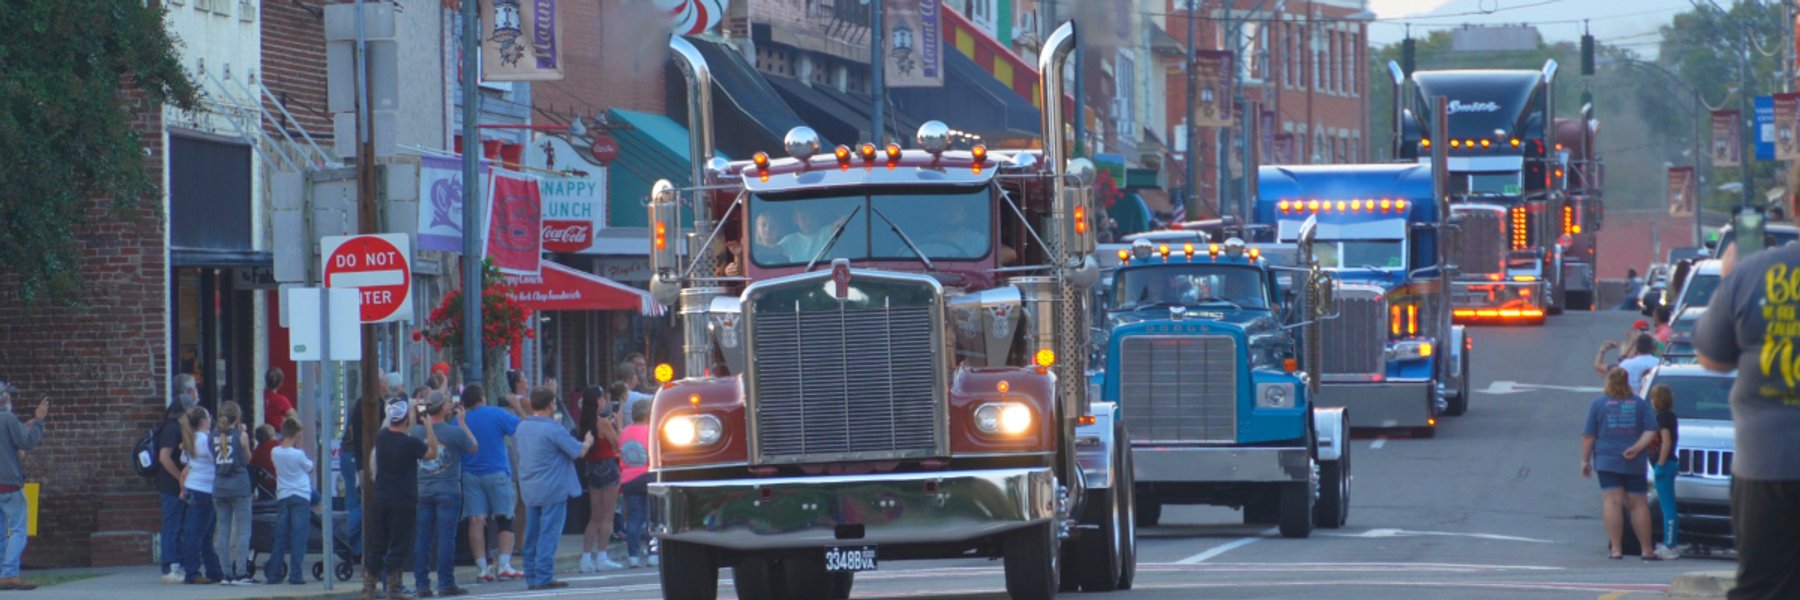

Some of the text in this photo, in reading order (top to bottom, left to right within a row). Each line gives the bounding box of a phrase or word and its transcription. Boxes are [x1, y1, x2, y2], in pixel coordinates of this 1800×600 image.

[541, 181, 596, 196] NAPPY
[336, 252, 395, 268] DO NOT
[360, 290, 392, 304] TER
